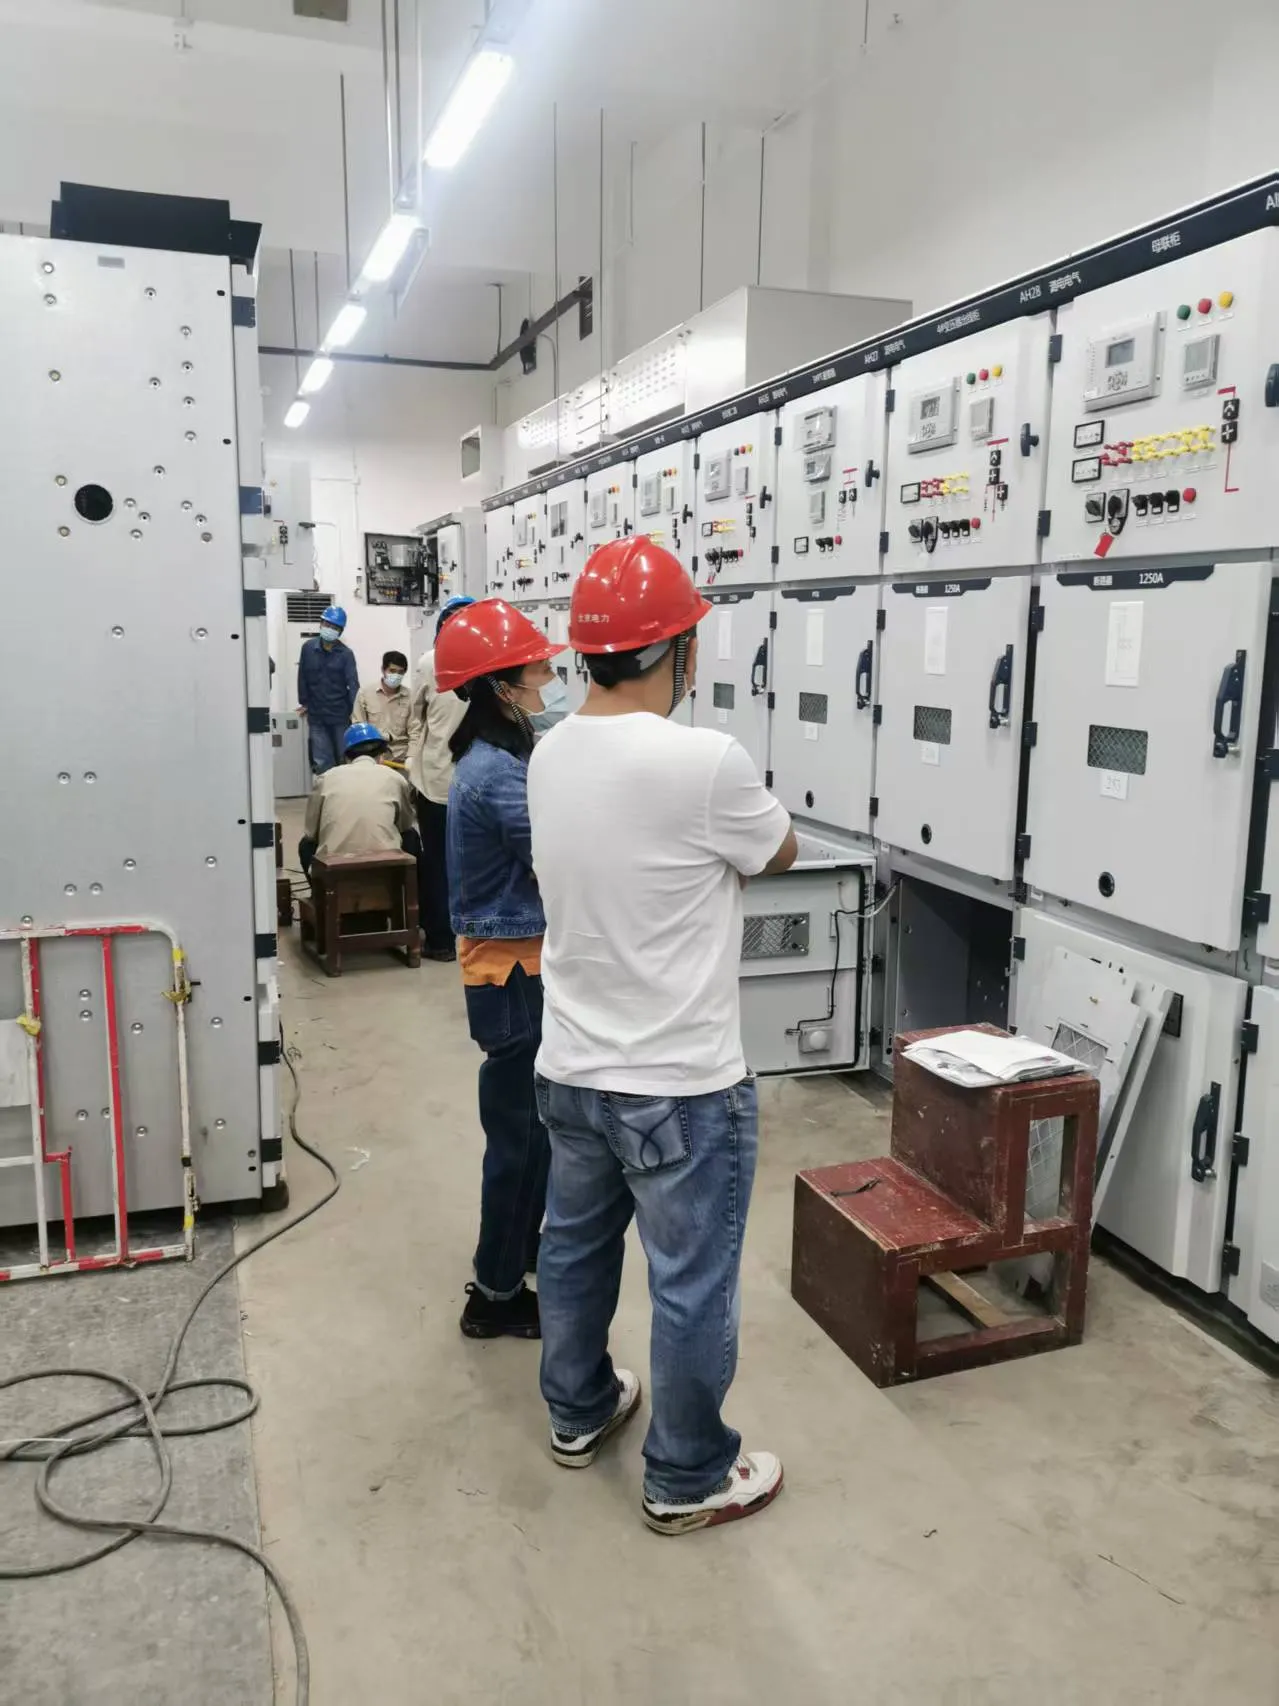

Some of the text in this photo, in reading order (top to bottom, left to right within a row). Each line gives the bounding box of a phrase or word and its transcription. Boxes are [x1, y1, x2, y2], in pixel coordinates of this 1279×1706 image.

[1151, 230, 1182, 253] 母联柜
[1019, 284, 1042, 304] AH28
[1138, 572, 1164, 585] 1250A
